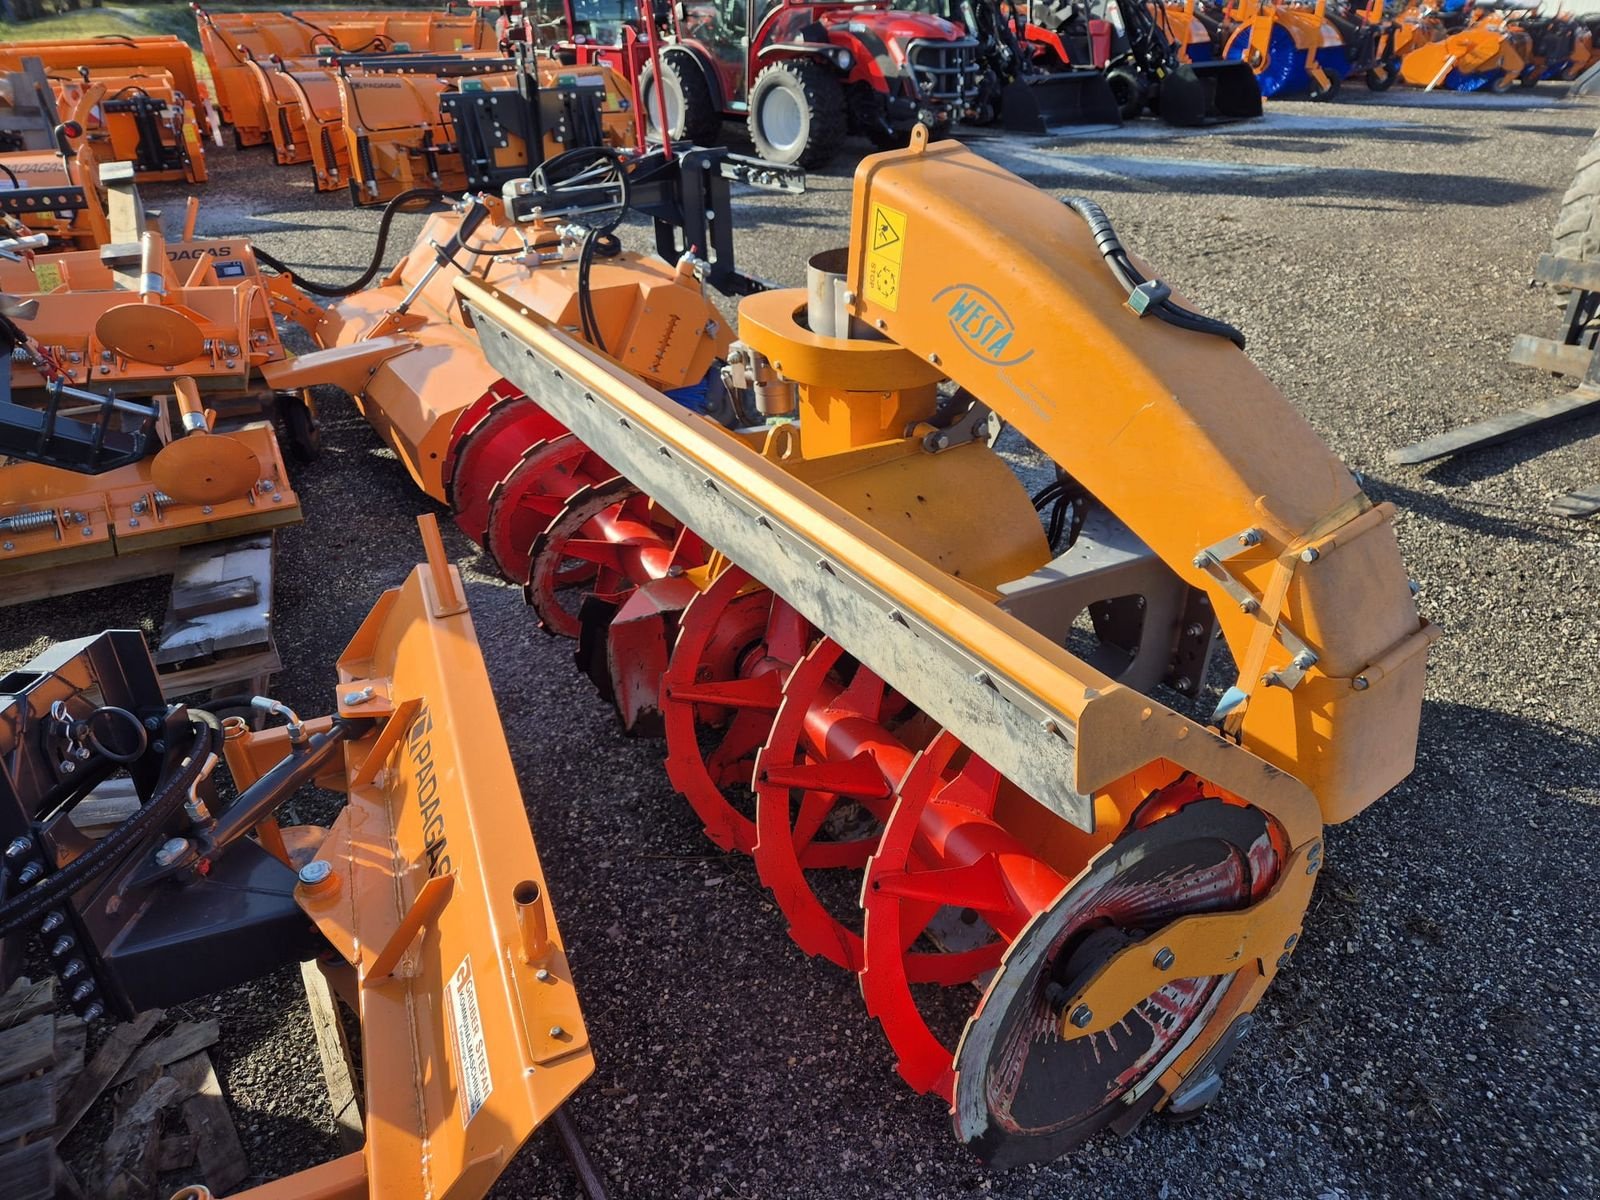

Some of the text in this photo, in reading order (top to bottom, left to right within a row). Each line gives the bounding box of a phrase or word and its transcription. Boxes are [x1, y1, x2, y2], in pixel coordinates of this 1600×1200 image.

[869, 262, 877, 289] STOP
[947, 290, 1015, 359] WESTA
[459, 990, 482, 1109] KOMMUNALMASCHINEN
[465, 979, 480, 1038] GRUBER
[475, 1039, 491, 1099] STEFAN
